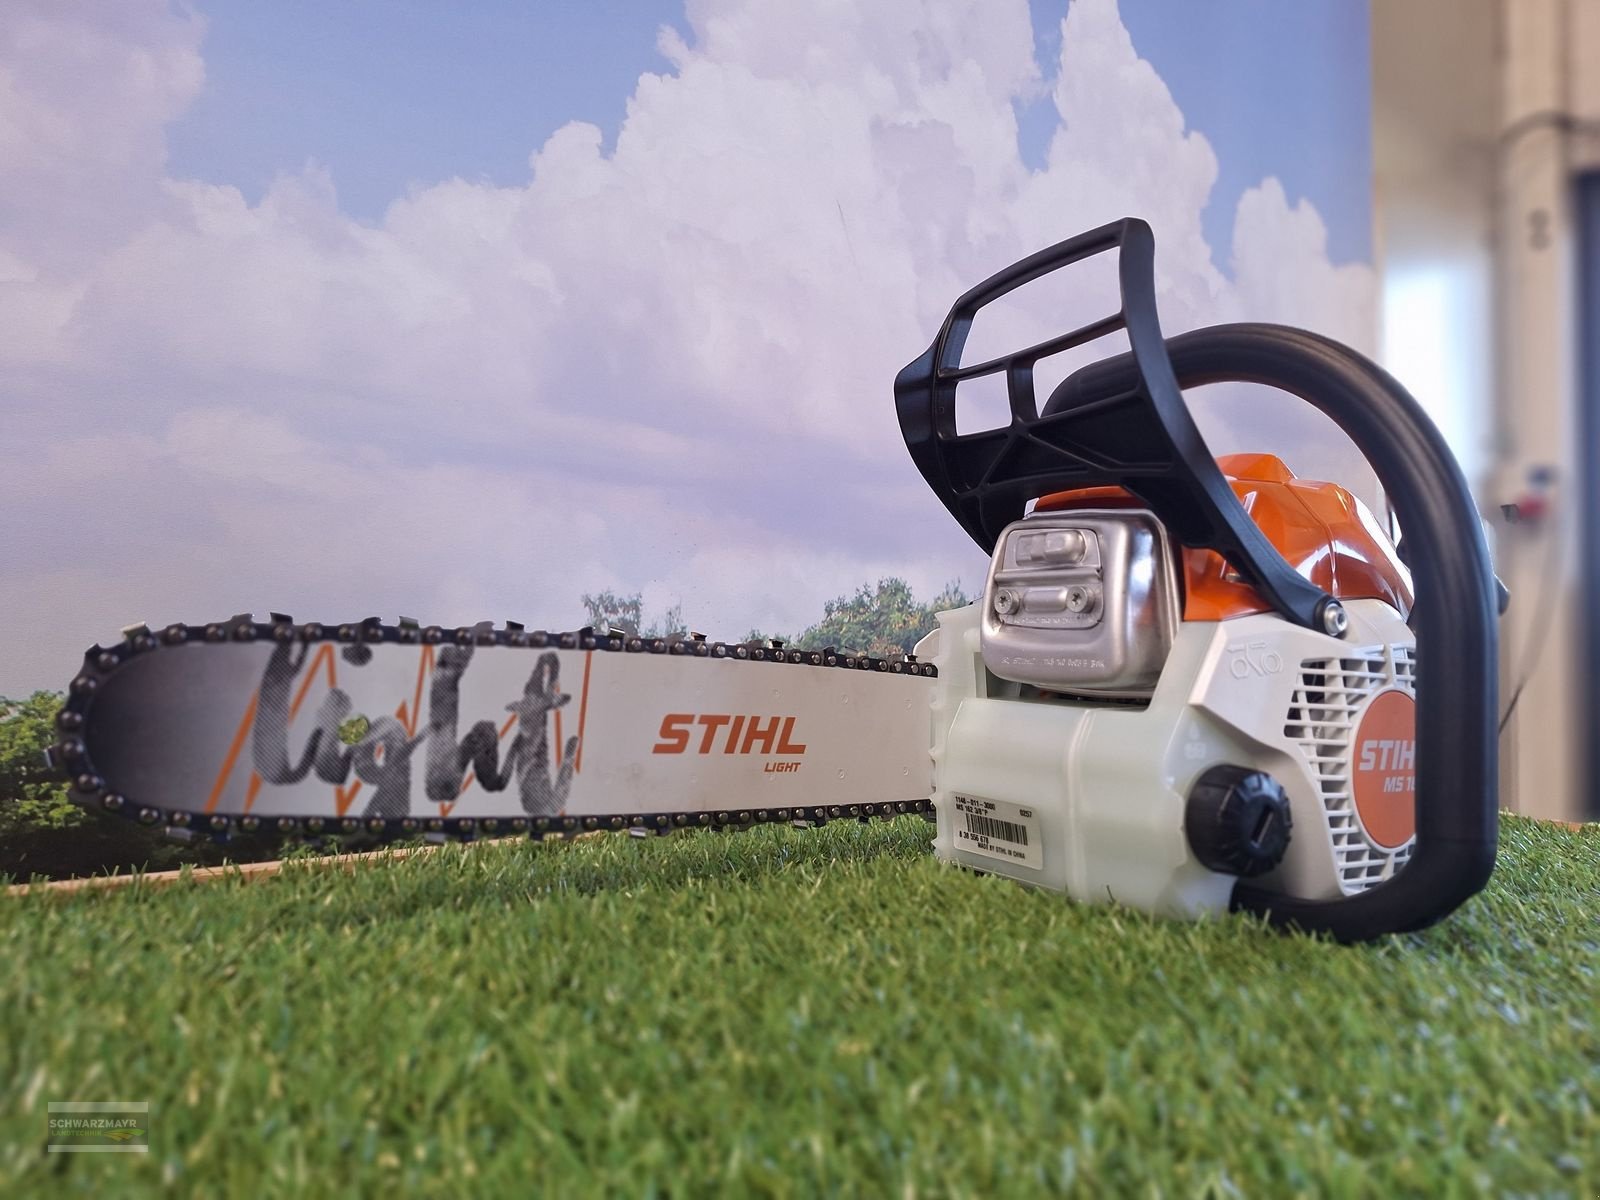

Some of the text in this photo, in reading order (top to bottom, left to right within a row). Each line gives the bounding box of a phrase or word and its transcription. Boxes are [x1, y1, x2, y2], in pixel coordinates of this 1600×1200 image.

[652, 714, 806, 754] STIHL
[1359, 740, 1415, 770] STIH
[764, 762, 801, 772] LIGHT
[1384, 776, 1404, 792] MS
[956, 803, 964, 811] MS
[965, 805, 974, 813] 162
[977, 842, 989, 850] MADE
[996, 846, 1007, 855] STIHL
[1013, 851, 1025, 859] CHINA
